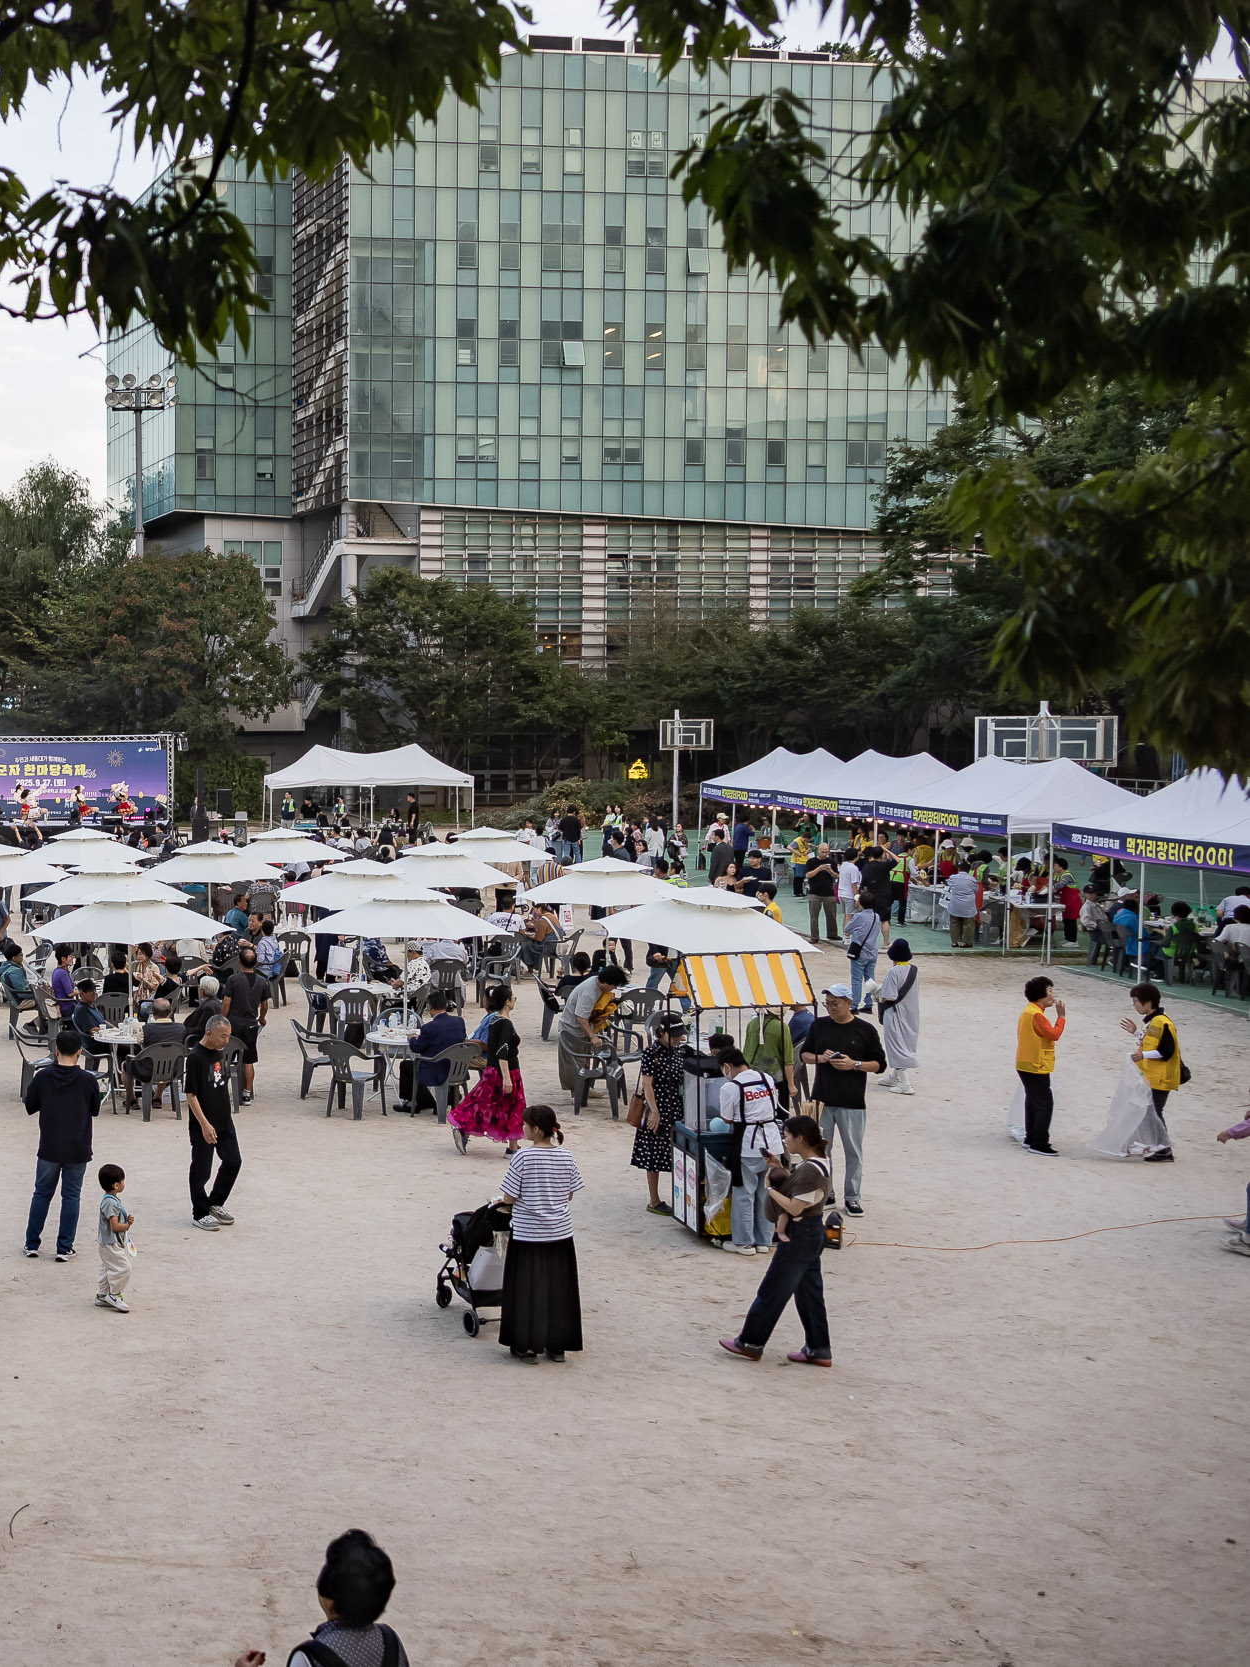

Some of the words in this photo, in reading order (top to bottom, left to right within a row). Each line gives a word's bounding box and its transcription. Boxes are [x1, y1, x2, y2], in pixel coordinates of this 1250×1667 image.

[24, 764, 86, 776] 한마당축제
[1071, 833, 1082, 844] 2025
[1082, 834, 1092, 846] 군자
[1092, 836, 1120, 850] 한마당축제
